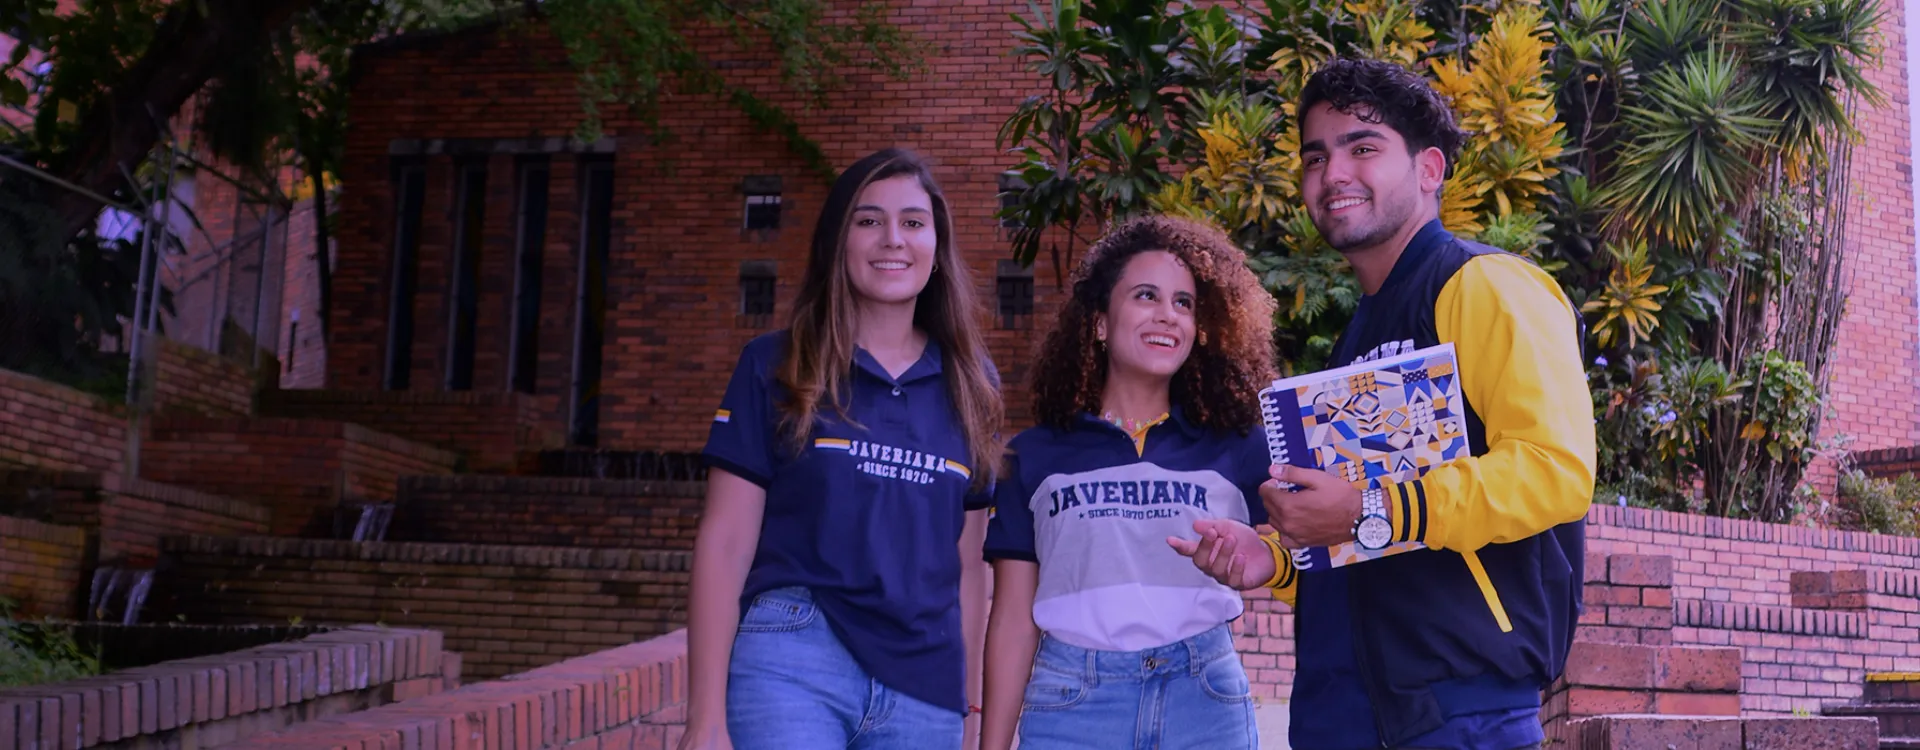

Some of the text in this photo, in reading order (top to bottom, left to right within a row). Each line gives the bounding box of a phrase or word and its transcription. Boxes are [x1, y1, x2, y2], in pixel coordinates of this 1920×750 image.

[849, 440, 946, 473] JAVERIANA
[863, 461, 898, 478] SINCE
[1049, 480, 1208, 517] JAVERIANA
[1088, 508, 1119, 519] SINCE
[1146, 508, 1171, 519] CALI
